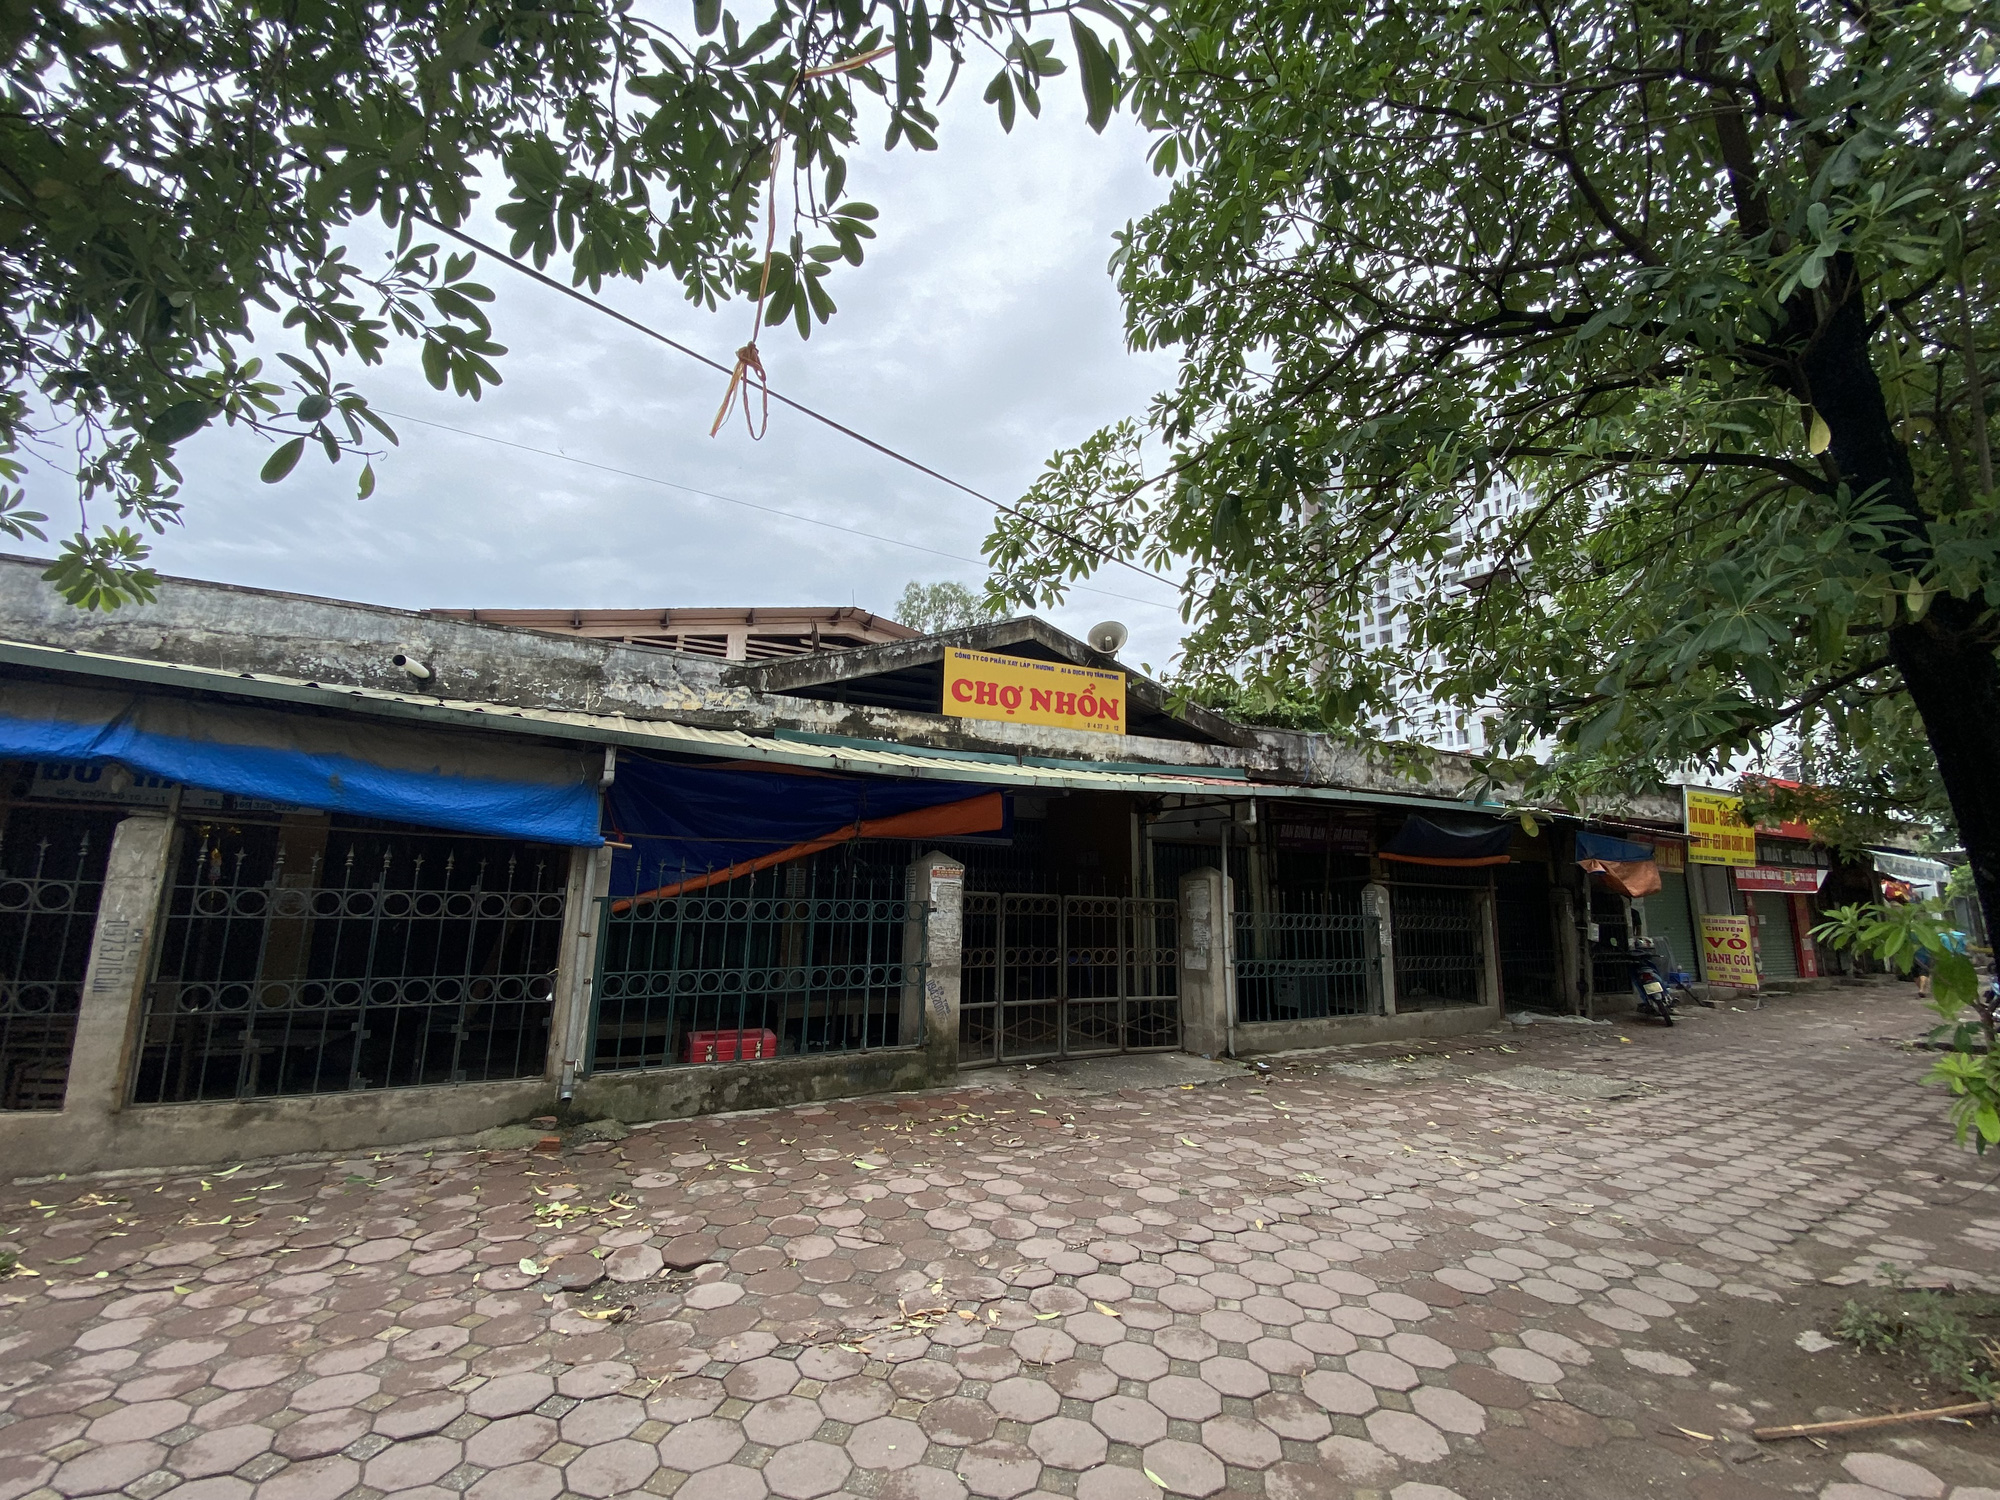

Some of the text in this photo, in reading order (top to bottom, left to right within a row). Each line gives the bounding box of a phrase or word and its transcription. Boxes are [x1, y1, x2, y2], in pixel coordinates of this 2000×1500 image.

[954, 651, 971, 660] CÔNG
[951, 678, 1120, 721] CHỢ NHỔN
[1704, 933, 1748, 950] VỎ
[1706, 949, 1732, 965] BÁNH
